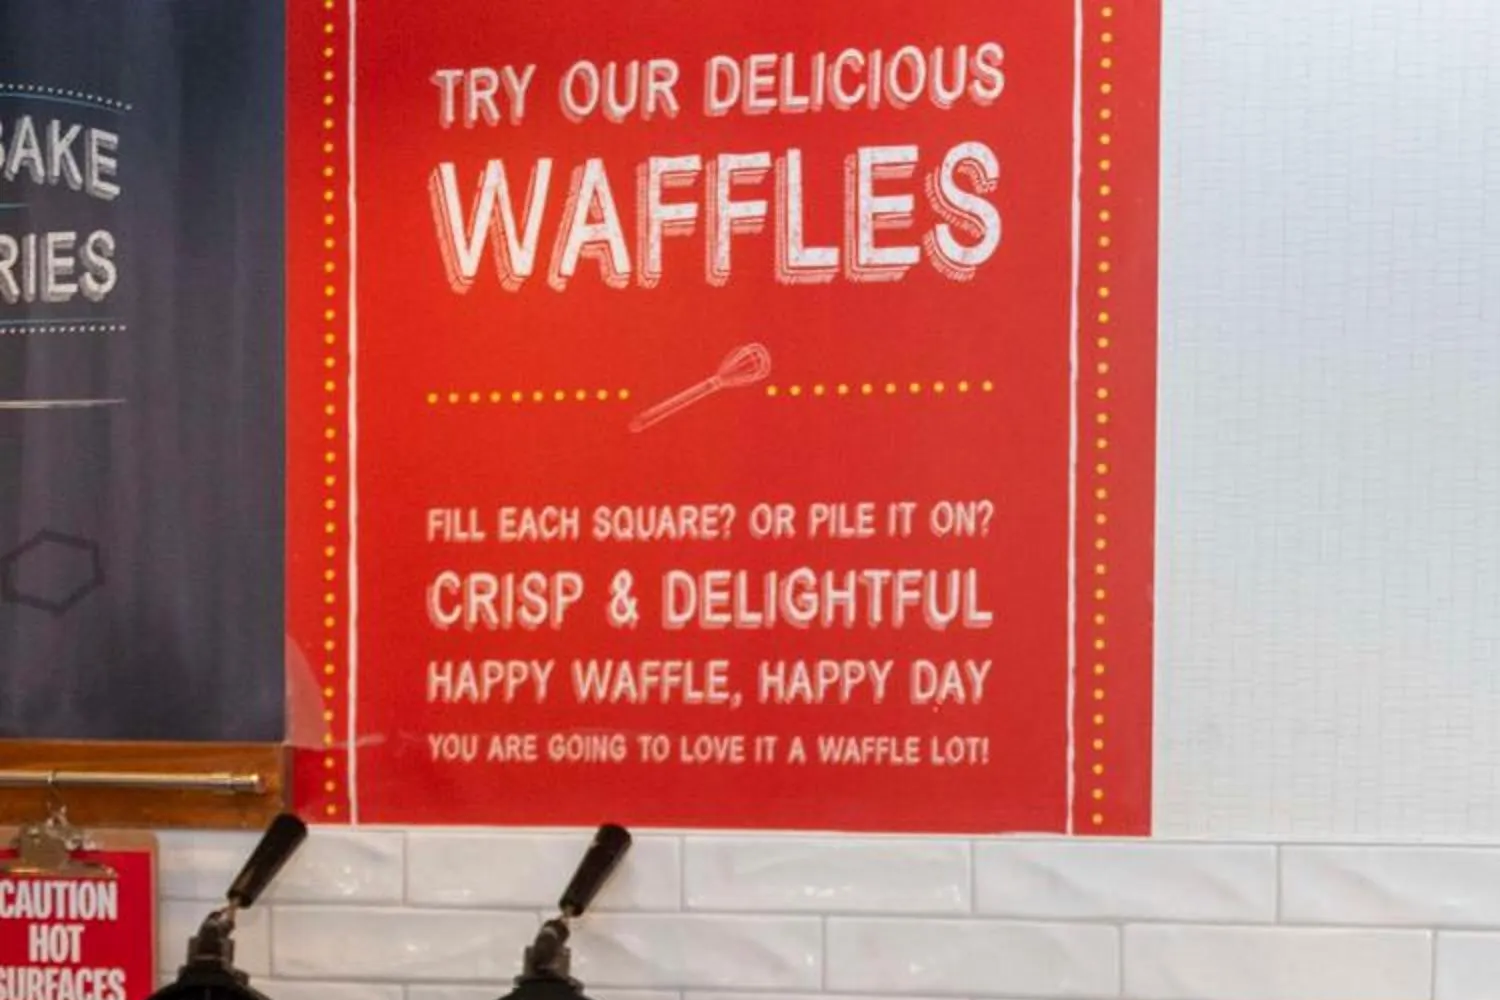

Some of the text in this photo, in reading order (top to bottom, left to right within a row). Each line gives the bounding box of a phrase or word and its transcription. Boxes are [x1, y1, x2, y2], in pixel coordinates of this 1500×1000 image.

[430, 42, 1006, 128] TRY OUR DELICIOUS
[0, 114, 121, 201] AKE
[428, 141, 1001, 293] WAFFLES
[427, 500, 994, 541] FILL EACH SQUARE? OR PILE IT ON?
[427, 567, 993, 630] CRISP & DELIGHTFUL
[427, 659, 992, 709] HAPPY WAFFLE, HAPPY DAY
[428, 734, 990, 765] YOU ARE GOING TO LOVE IT A WAFFLE LOT!
[0, 880, 118, 920] CAUTION
[28, 924, 85, 963] HOT
